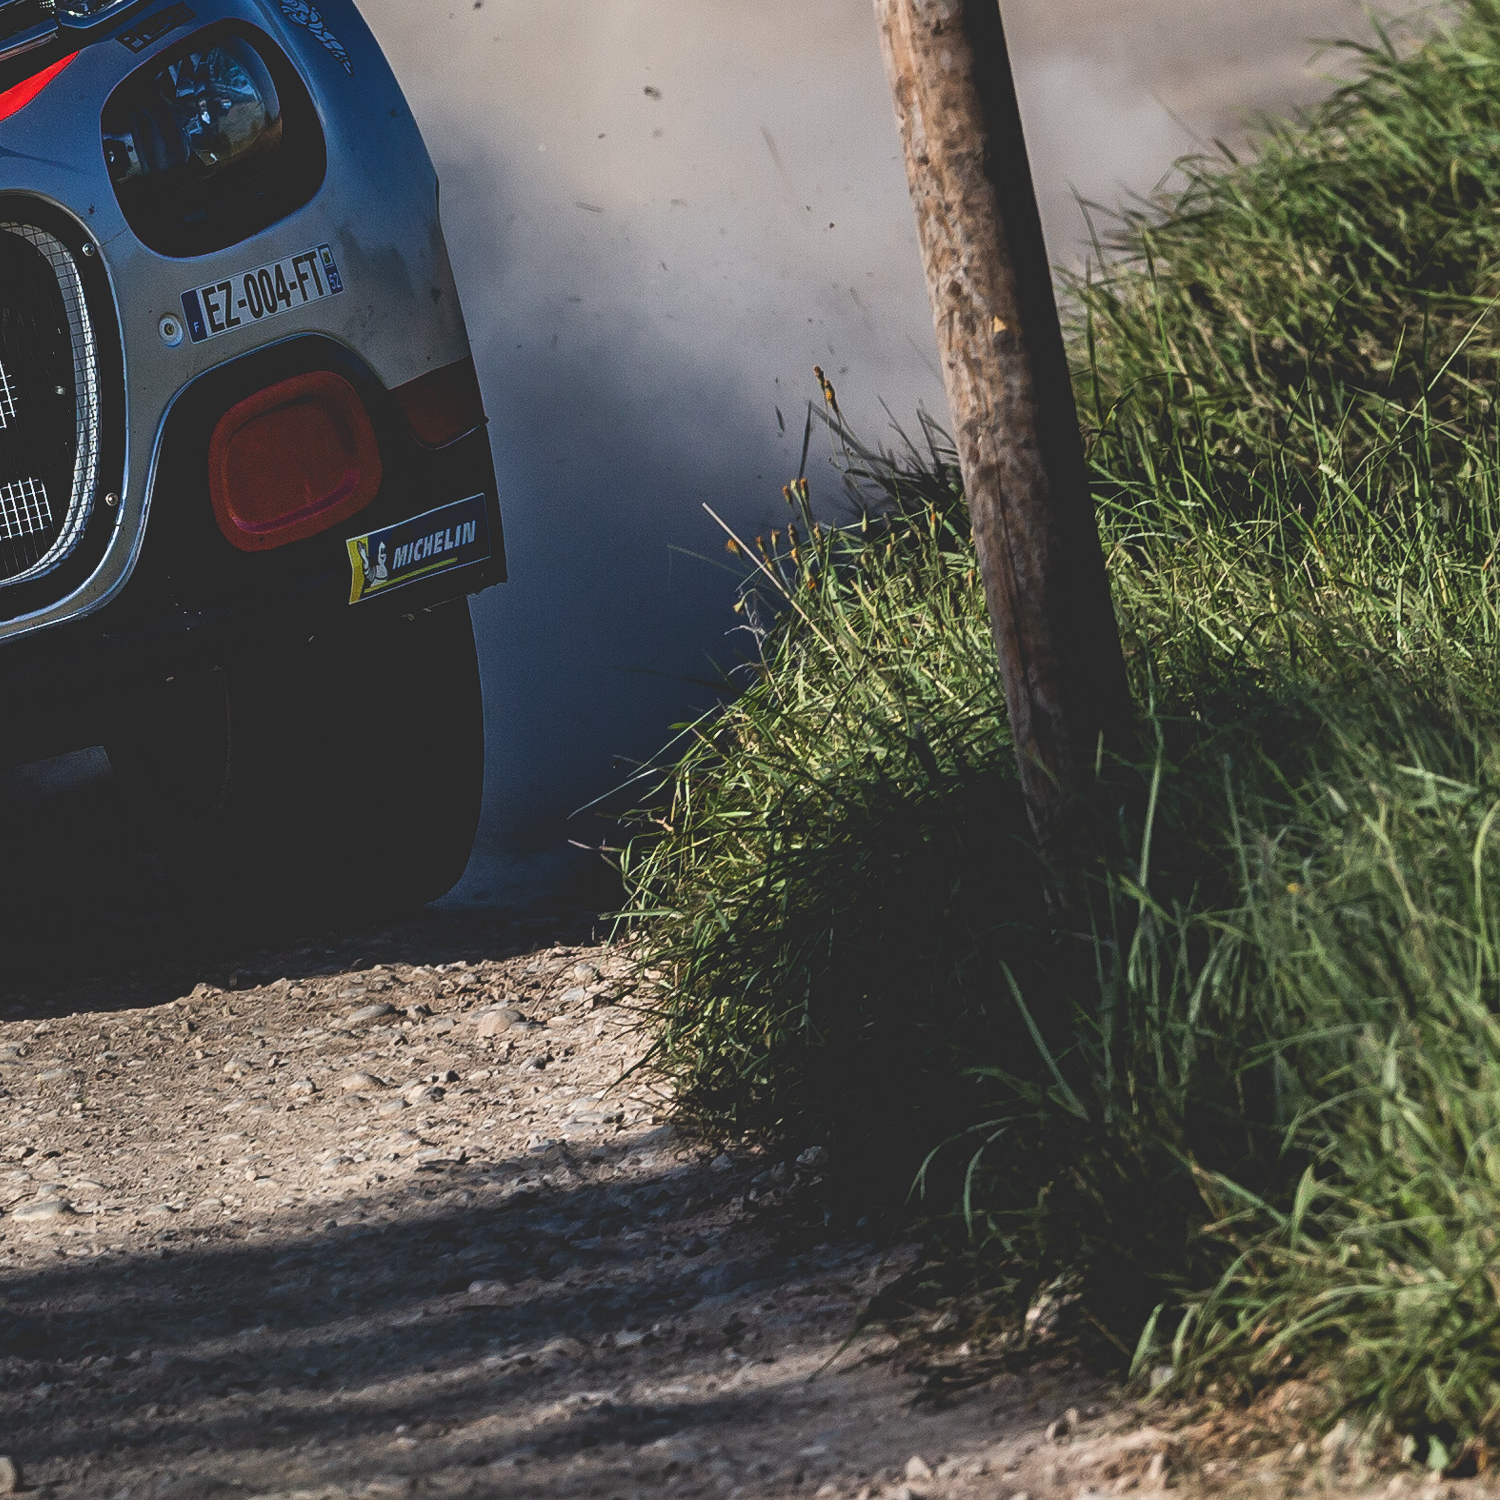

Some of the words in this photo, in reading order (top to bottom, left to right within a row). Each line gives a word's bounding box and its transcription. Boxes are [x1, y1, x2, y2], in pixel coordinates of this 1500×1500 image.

[201, 250, 324, 334] EZ-004-FT
[328, 273, 342, 290] 52
[392, 520, 476, 570] MICHELIN
